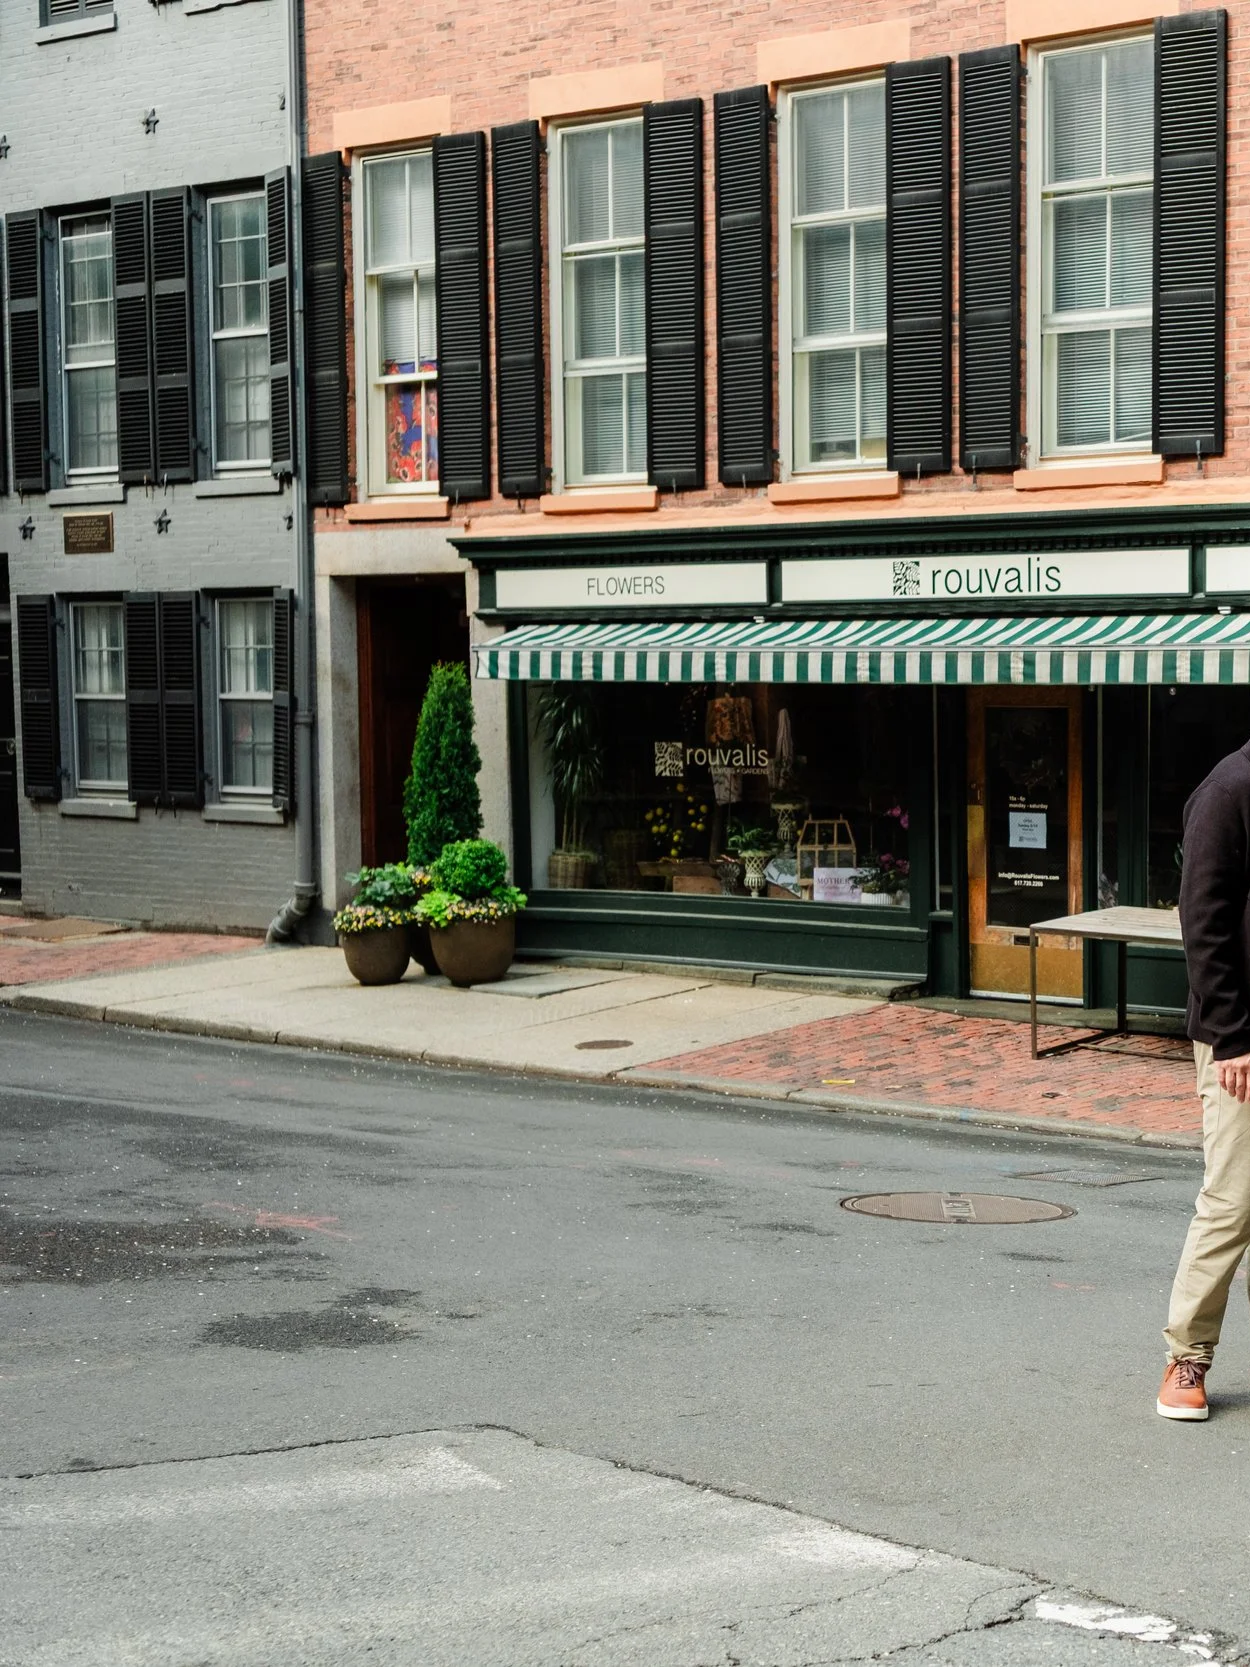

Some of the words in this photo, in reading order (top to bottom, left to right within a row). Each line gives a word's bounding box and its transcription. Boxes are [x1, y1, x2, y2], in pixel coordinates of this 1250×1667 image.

[587, 575, 665, 596] FLOWERS
[931, 556, 1061, 594] rouvalis
[686, 743, 769, 766] rouvalis
